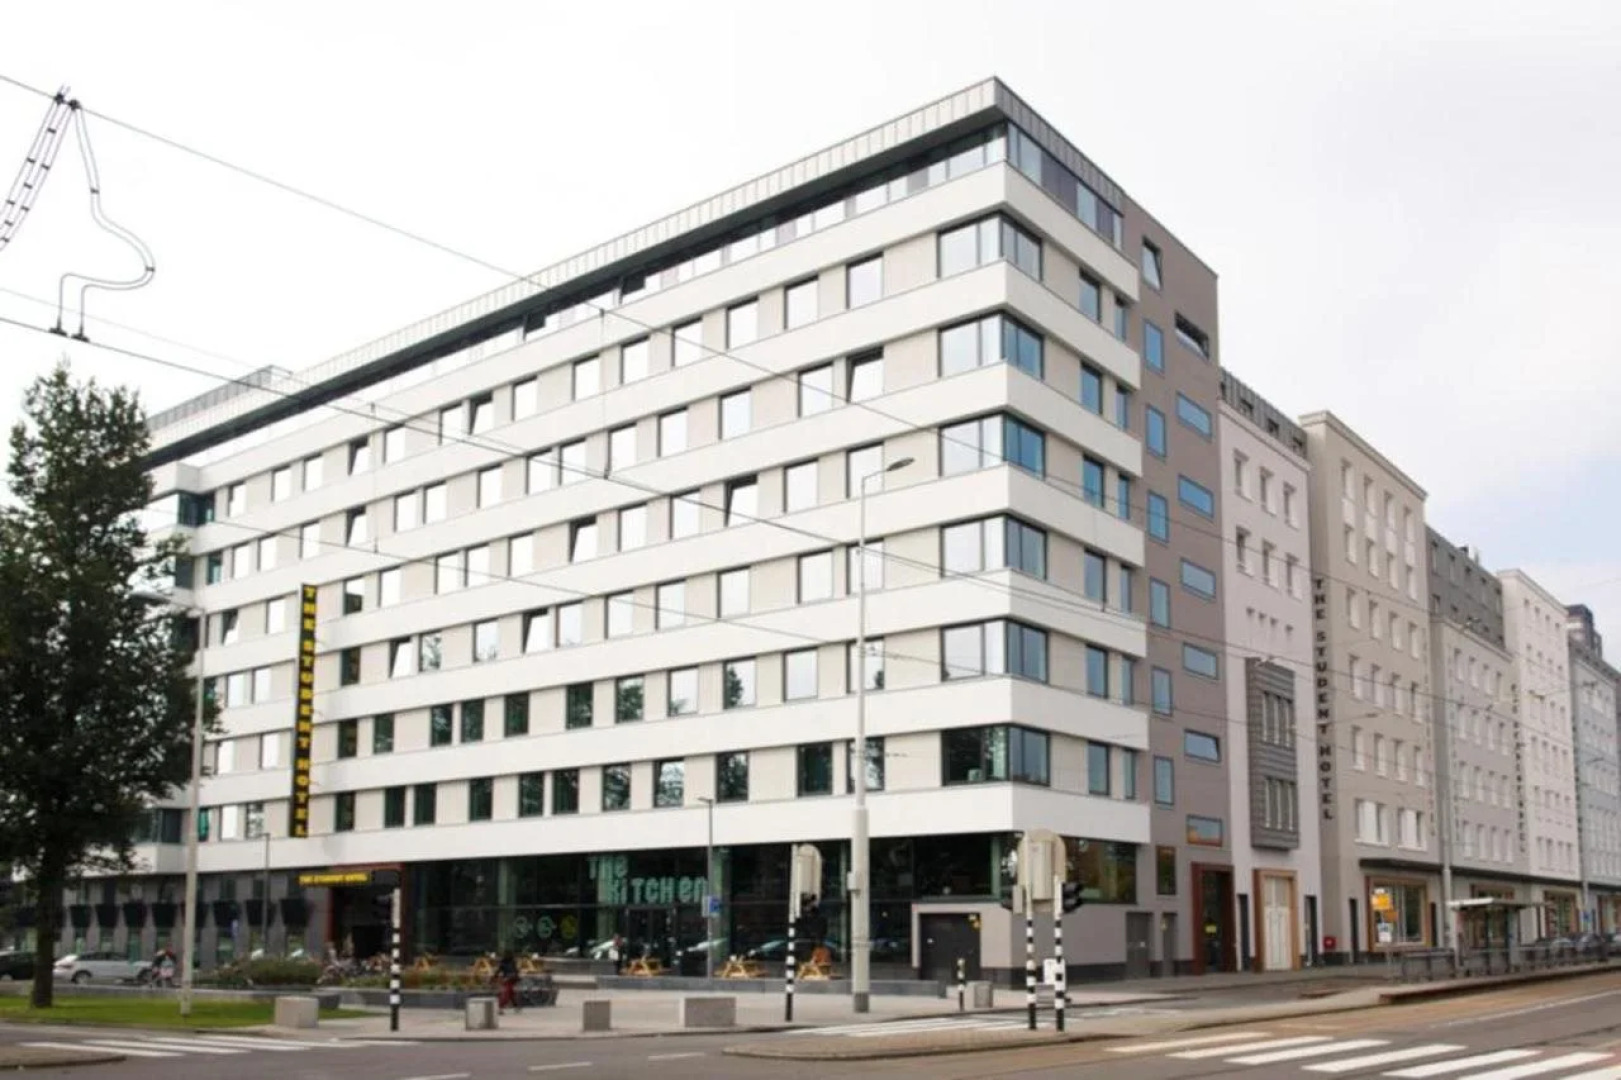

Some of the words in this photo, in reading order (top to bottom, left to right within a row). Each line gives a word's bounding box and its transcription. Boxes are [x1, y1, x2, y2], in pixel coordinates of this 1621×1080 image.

[1314, 578, 1326, 620] THE
[1316, 631, 1330, 735] STUDENT
[1319, 745, 1333, 821] HOTEL
